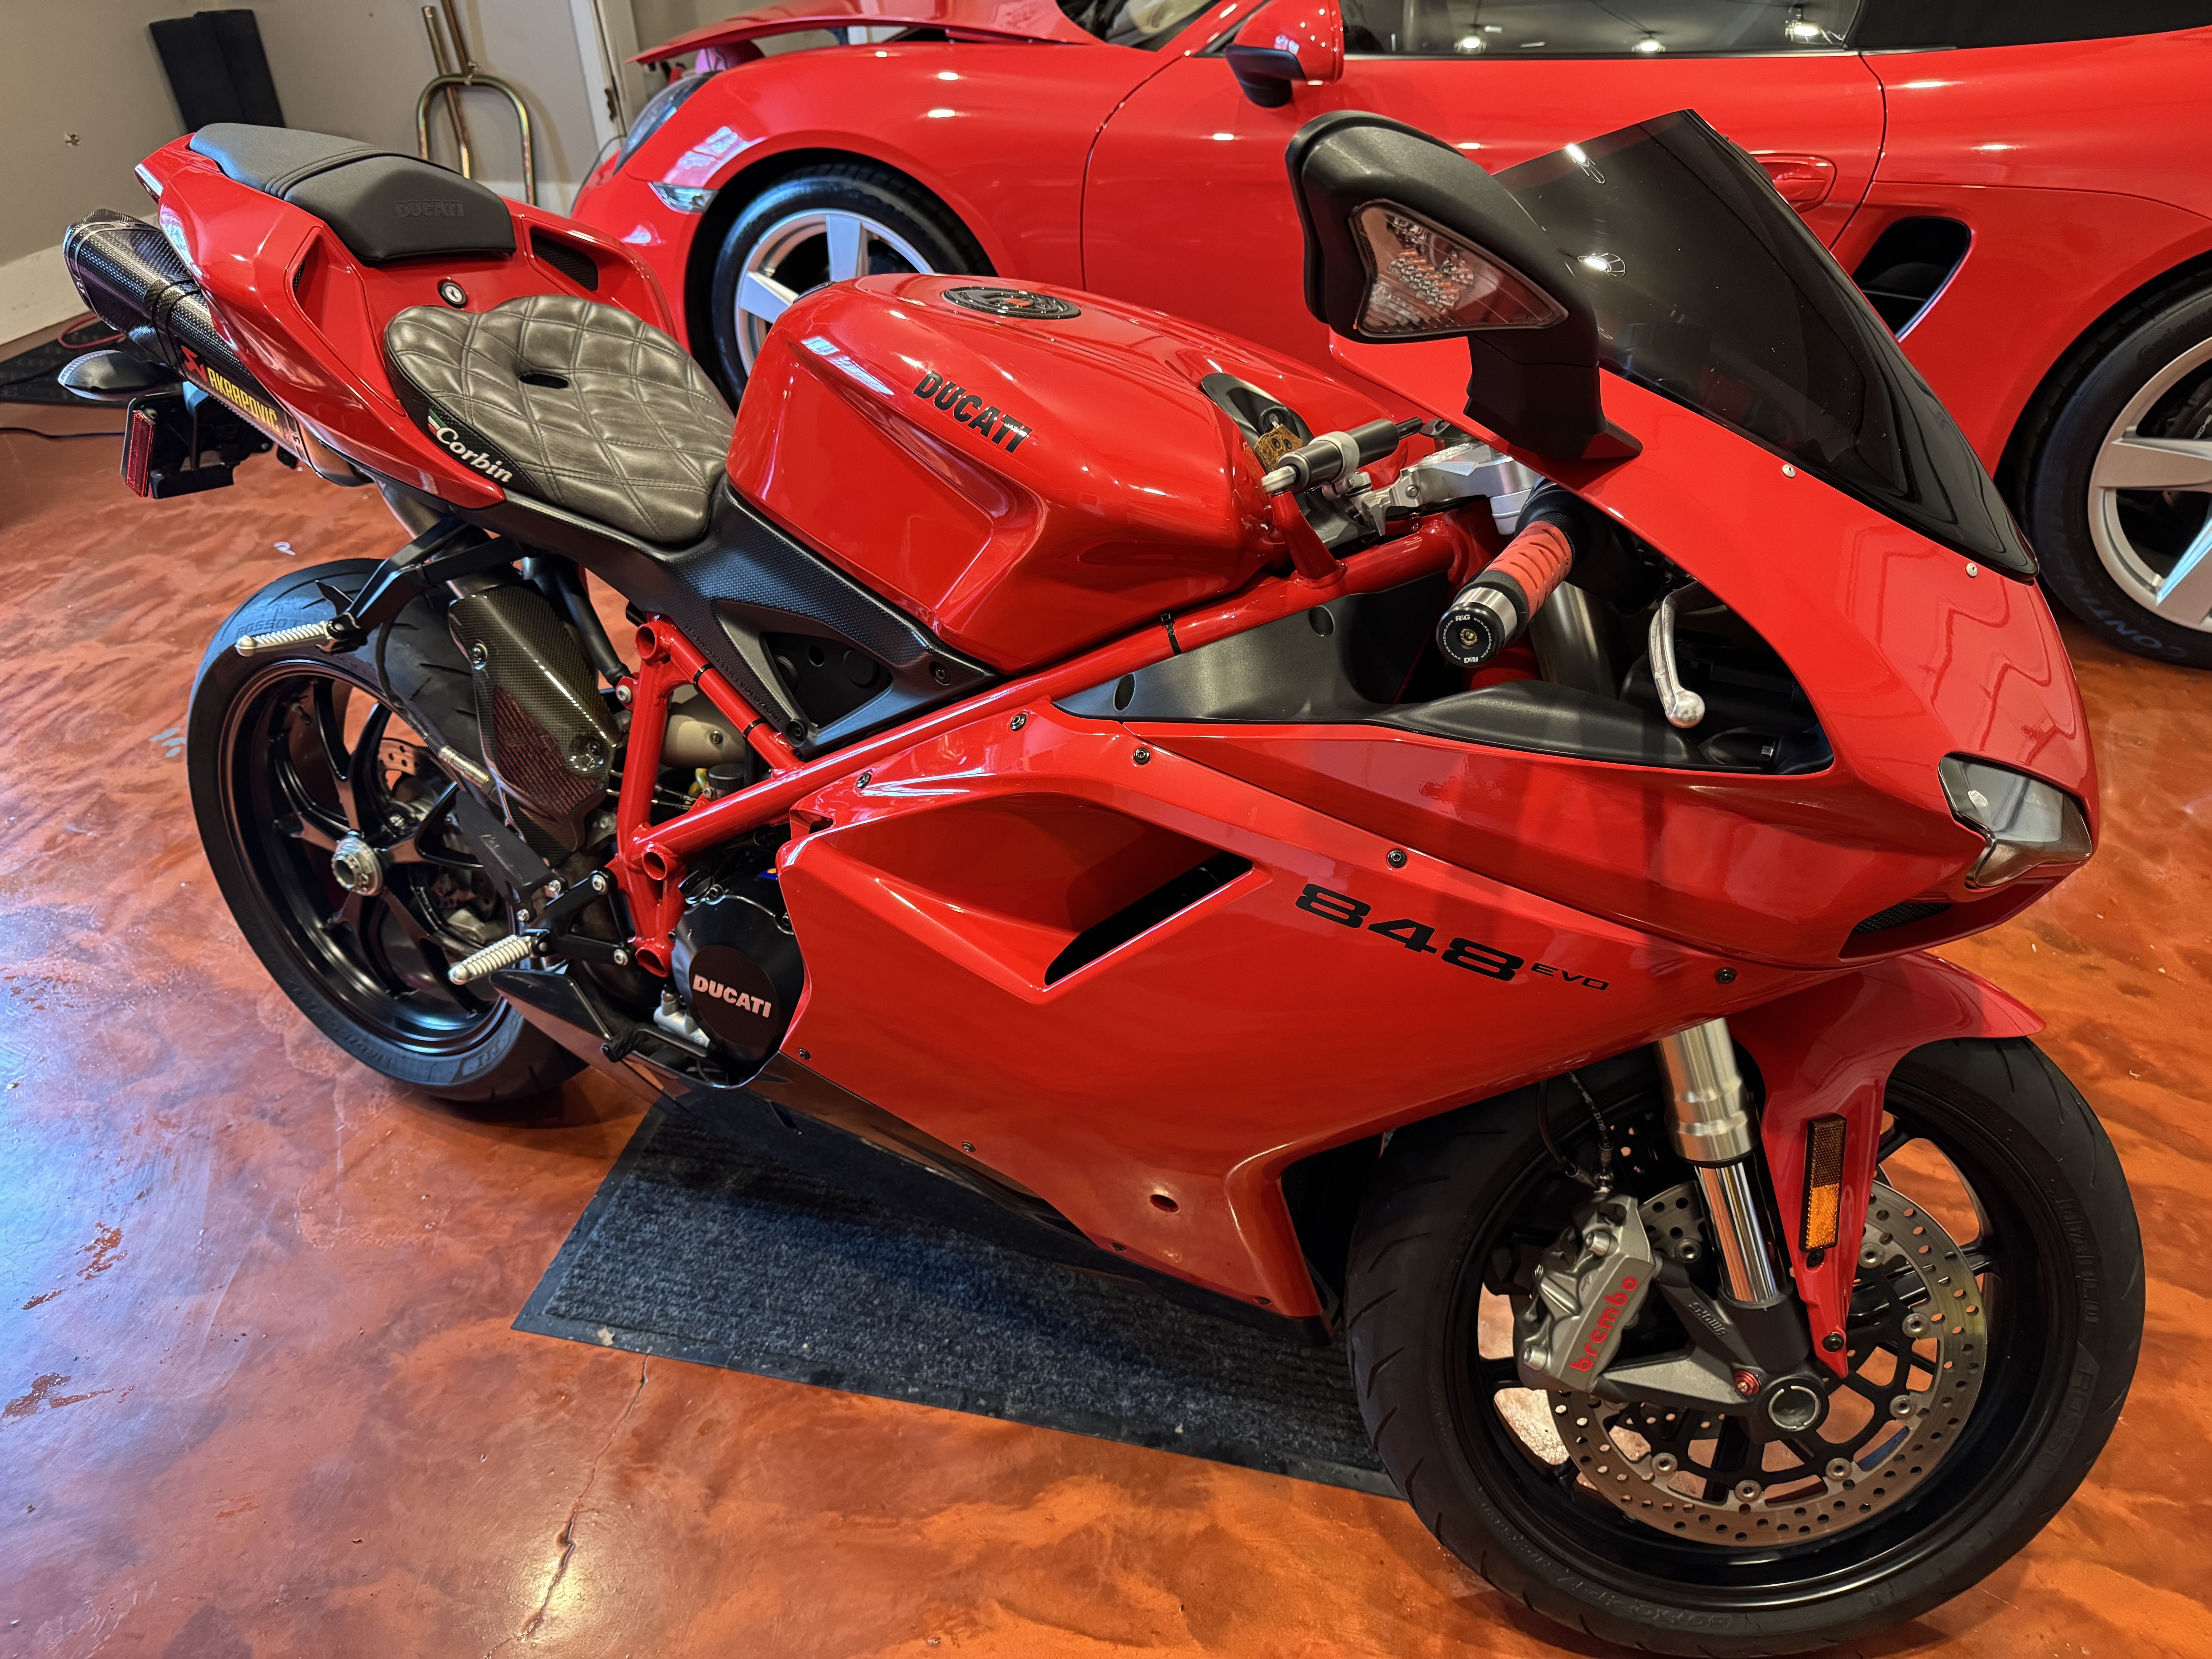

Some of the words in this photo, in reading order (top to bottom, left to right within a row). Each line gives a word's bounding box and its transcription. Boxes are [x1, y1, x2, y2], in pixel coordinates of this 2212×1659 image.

[394, 200, 464, 219] DUCATI
[913, 371, 1032, 453] DUCATI
[436, 428, 513, 482] Corbin
[1295, 883, 1525, 981] 848
[1530, 962, 1609, 991] EVO
[693, 974, 771, 1018] DUCATI
[1569, 1276, 1638, 1371] brembo
